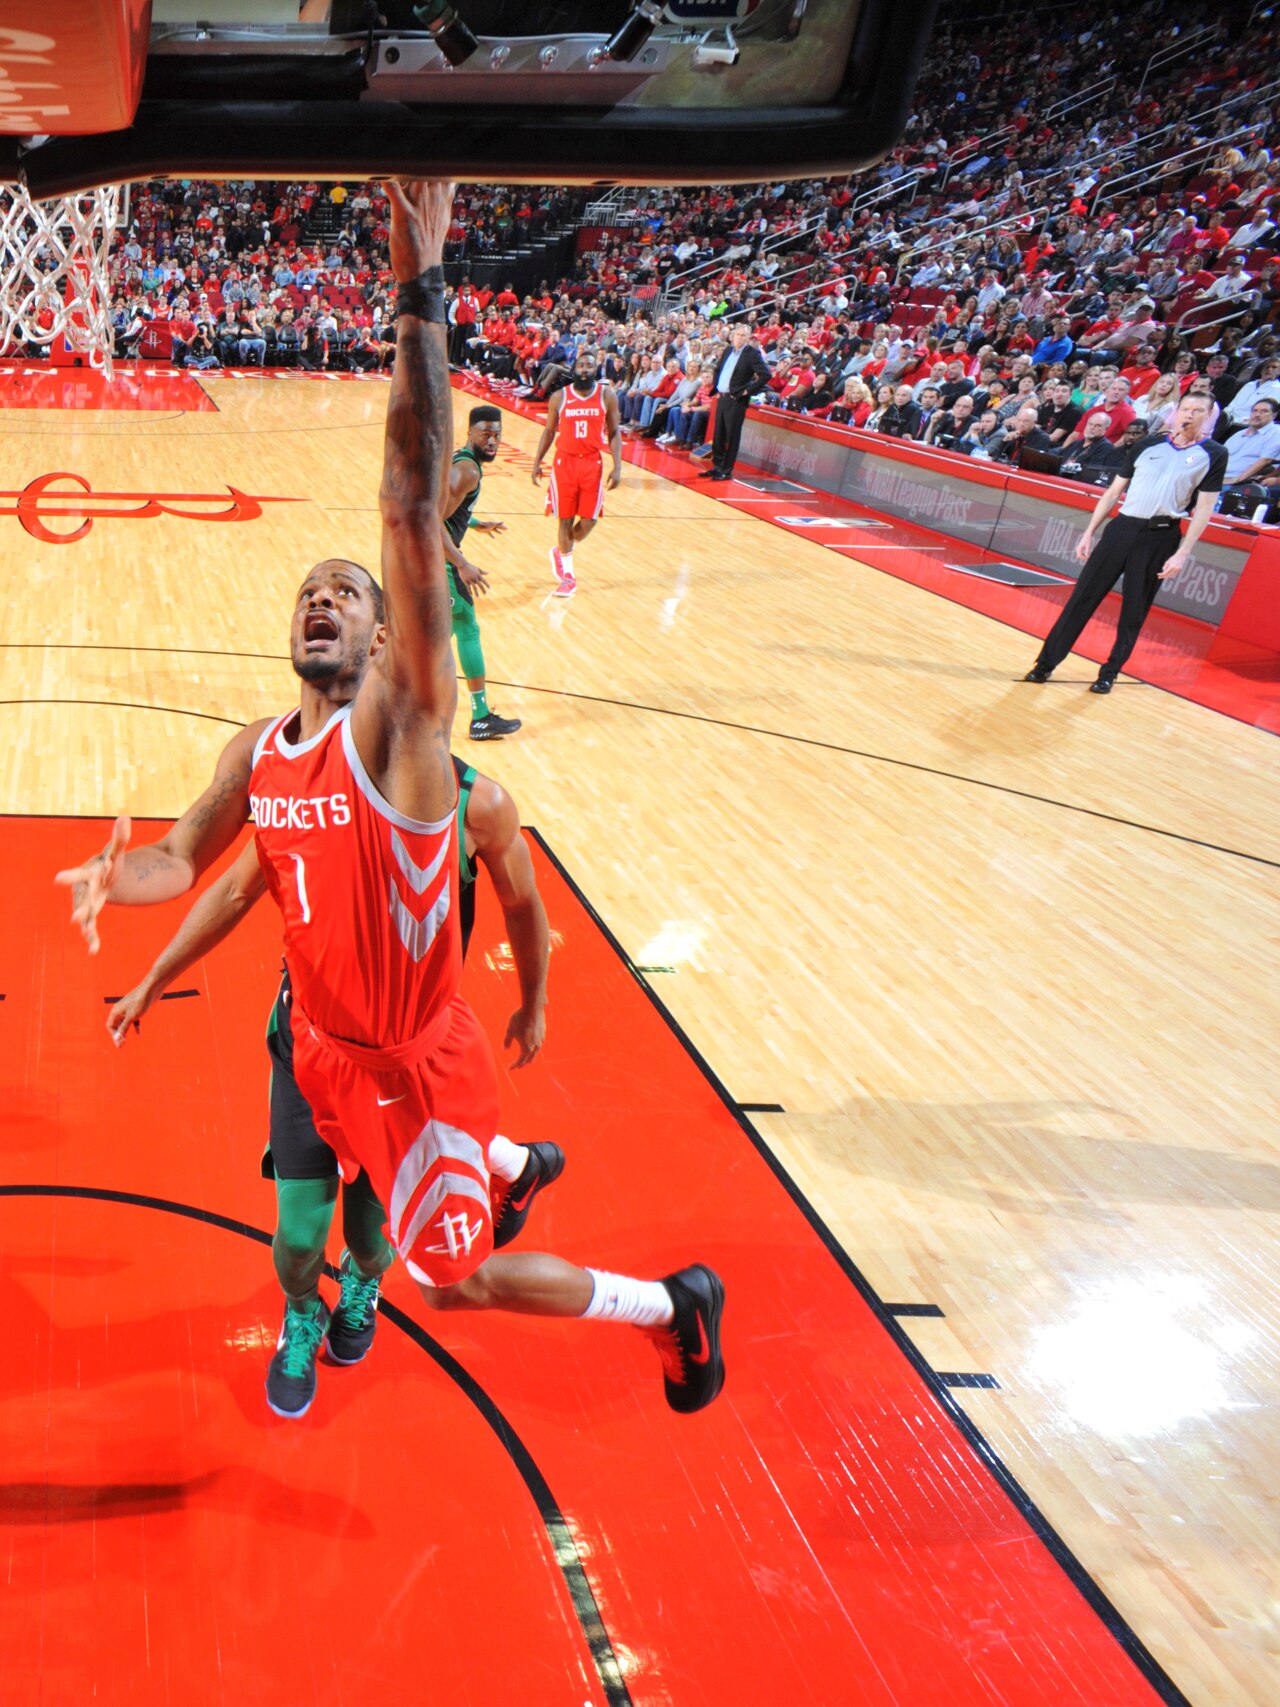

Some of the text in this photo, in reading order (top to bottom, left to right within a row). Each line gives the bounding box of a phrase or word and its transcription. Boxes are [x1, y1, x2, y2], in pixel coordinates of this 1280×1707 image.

[565, 408, 600, 417] ROCKETS
[575, 420, 588, 438] 13
[870, 465, 973, 526] NBA League Pass
[249, 792, 352, 830] ROCKETS
[287, 853, 311, 924] 1
